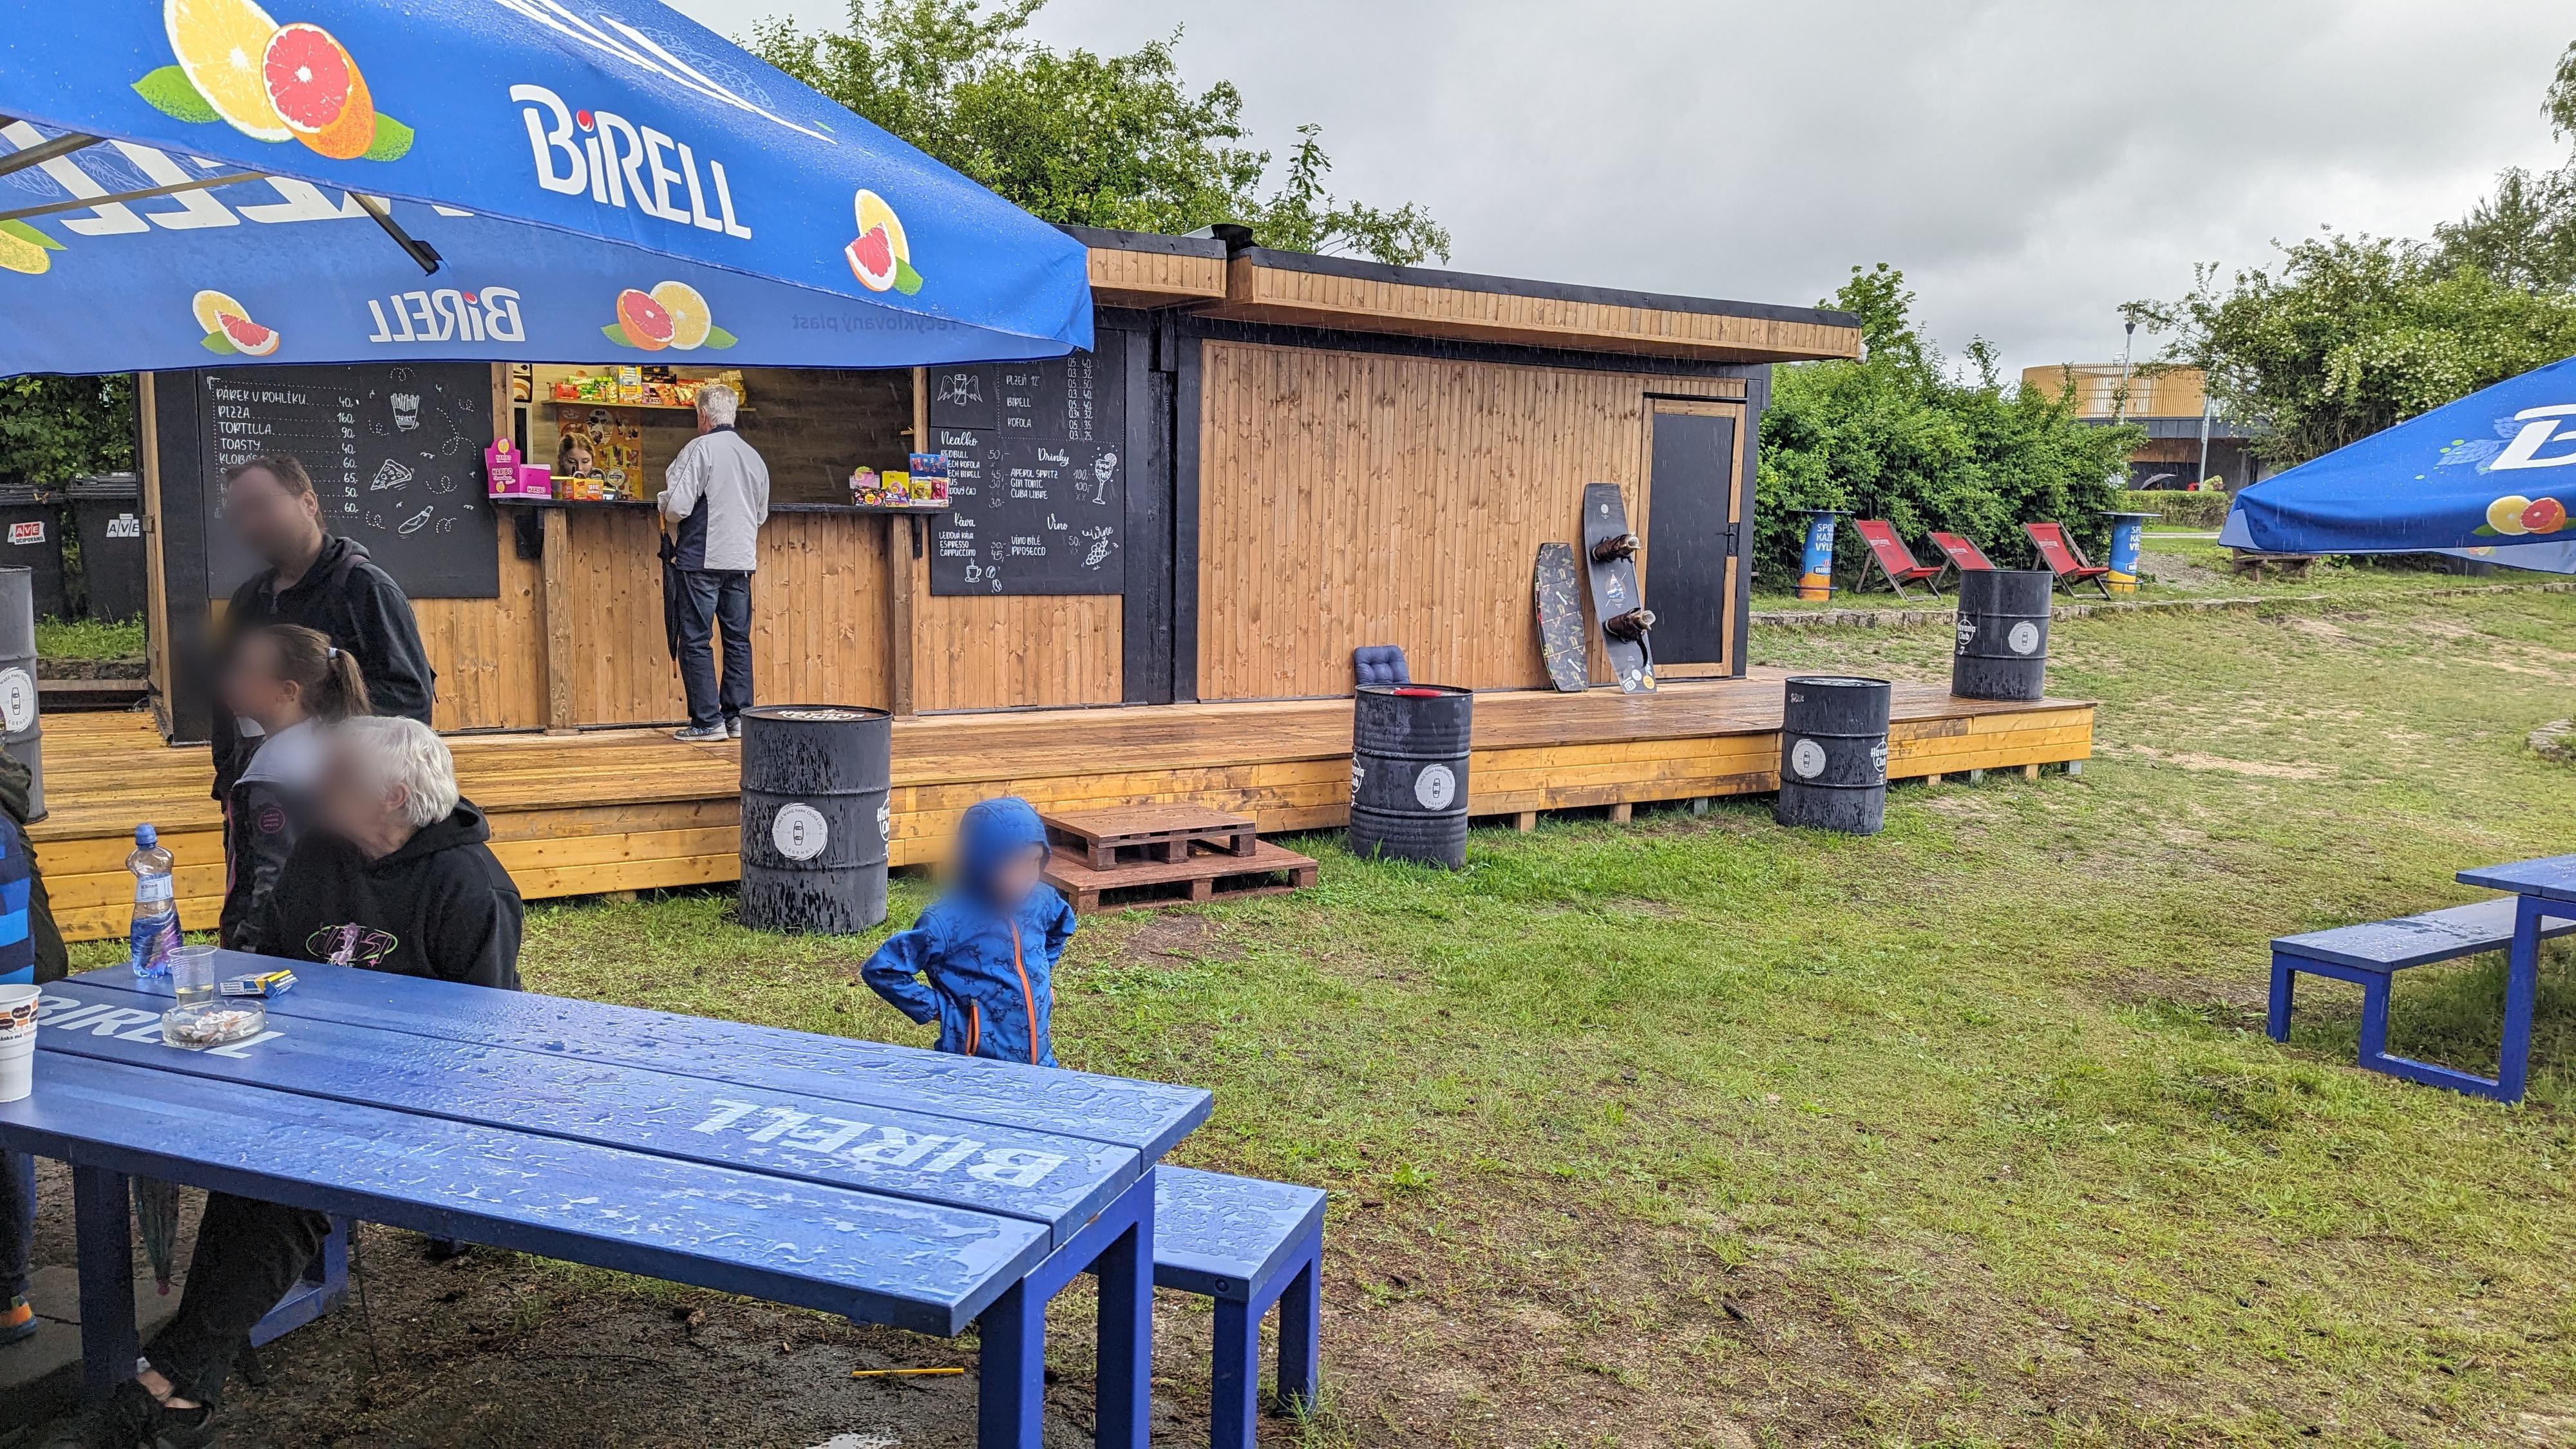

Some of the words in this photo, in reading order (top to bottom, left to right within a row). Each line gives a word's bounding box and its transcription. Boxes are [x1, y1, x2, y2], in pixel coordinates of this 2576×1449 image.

[216, 386, 249, 401] PÁREK
[252, 391, 259, 402] V
[263, 391, 306, 405] ROHLÍKU
[1007, 397, 1031, 408] BIRELL
[218, 405, 250, 419] PIZZA
[1008, 417, 1031, 428] KOFOLA
[218, 422, 271, 435] TORTILLA
[942, 431, 978, 446] Nealko
[220, 439, 260, 451] TOASTY
[1038, 448, 1070, 467] Drinky
[961, 470, 981, 478] BIRELL
[1010, 468, 1034, 477] APEROL
[1036, 469, 1057, 479] SPRITZ
[1010, 479, 1023, 488] GIN
[1025, 479, 1043, 488] TONIC
[1011, 489, 1027, 498] CUBA
[1029, 489, 1048, 500] LIBRE
[16, 526, 39, 535] AVE
[108, 523, 139, 533] AVE
[1012, 547, 1045, 556] PROSECCO
[784, 846, 813, 855] LEGENDS
[690, 1099, 1070, 1188] BIRELL
